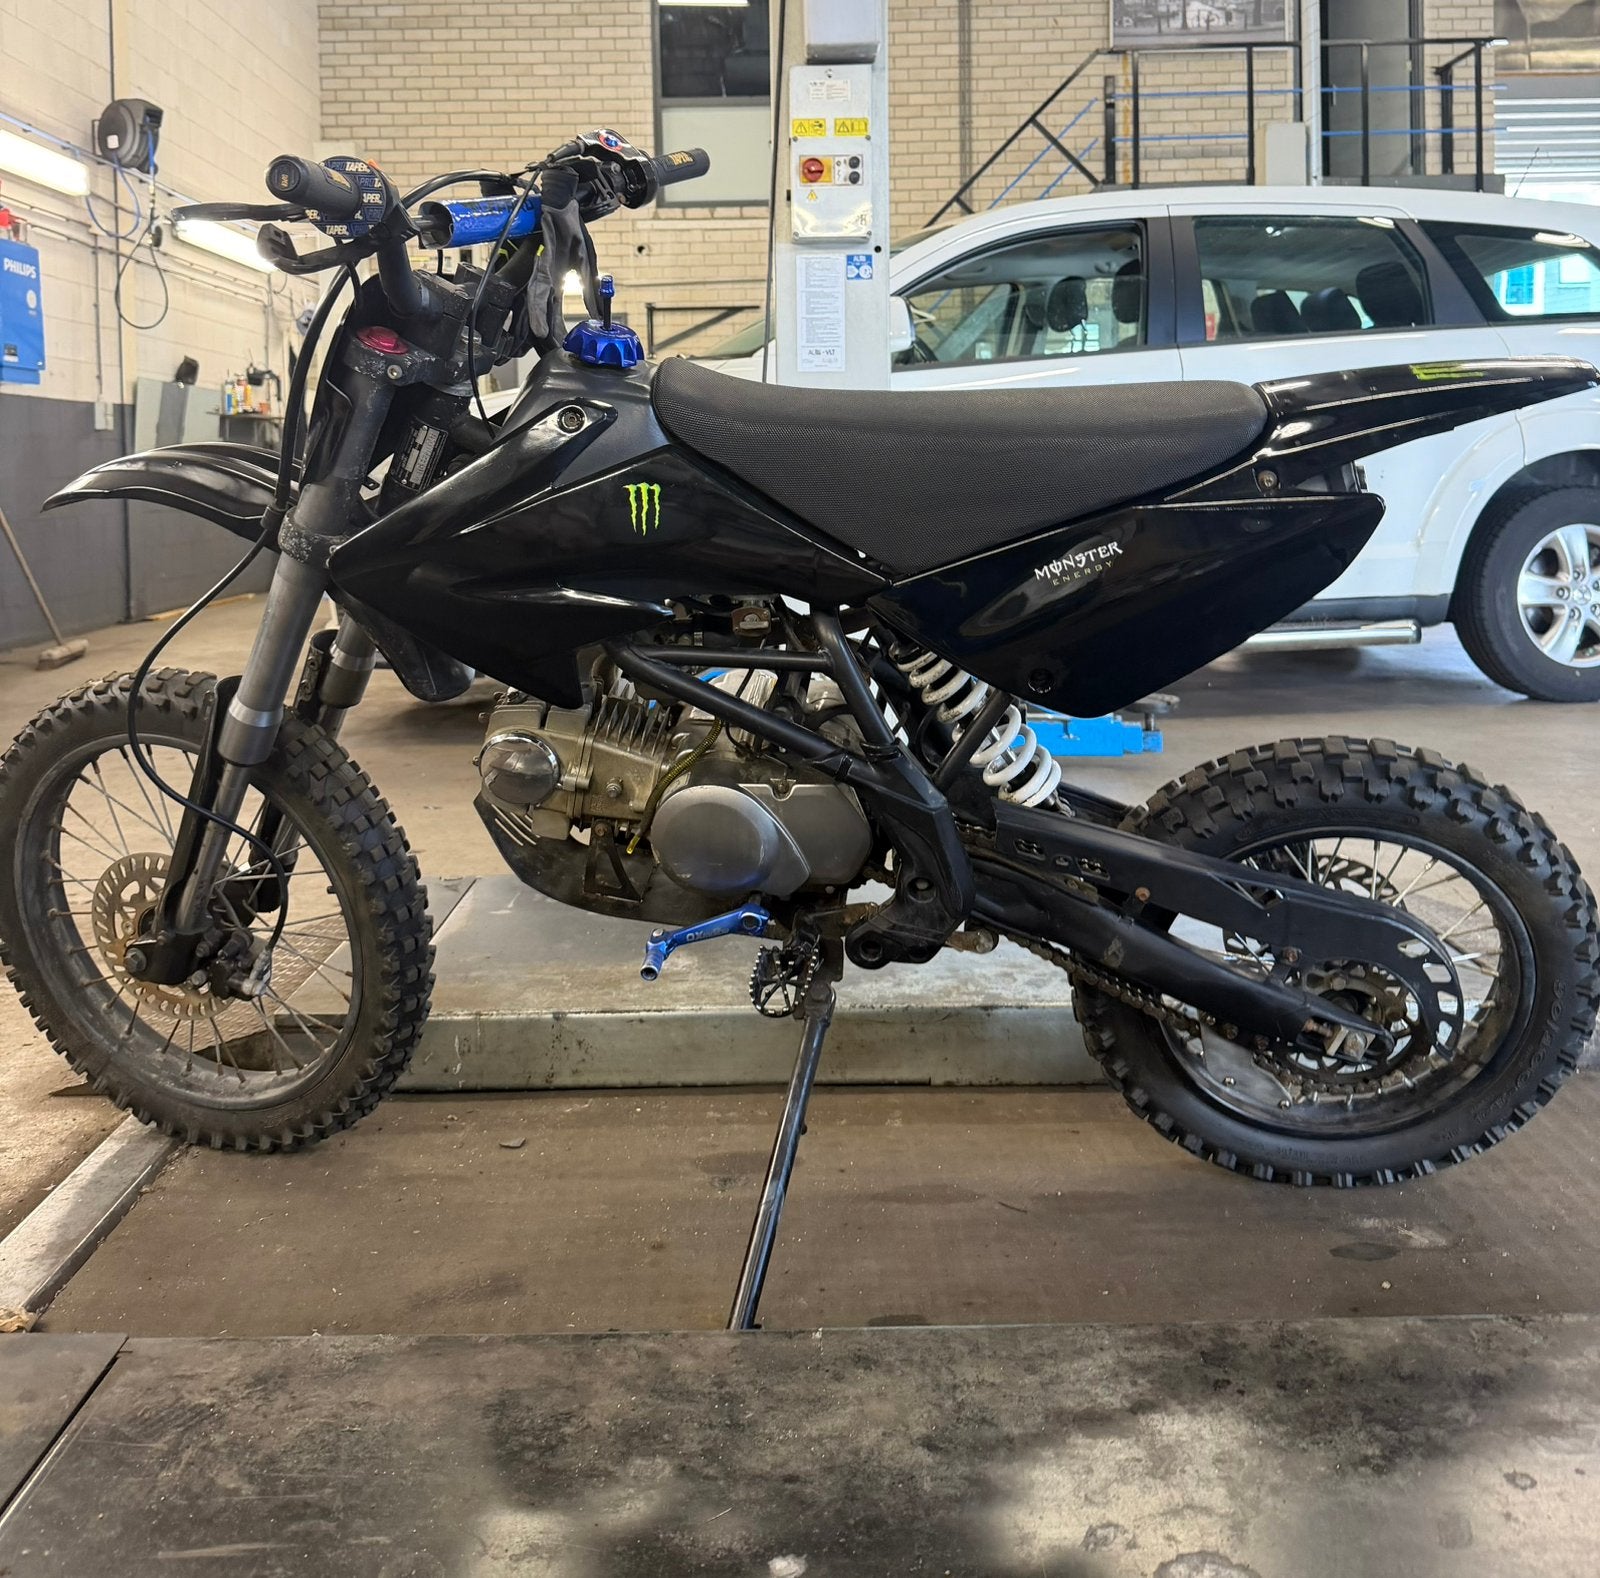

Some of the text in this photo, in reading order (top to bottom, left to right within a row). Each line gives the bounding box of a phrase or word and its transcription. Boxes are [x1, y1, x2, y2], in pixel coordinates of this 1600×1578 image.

[325, 224, 349, 236] TAPER
[4, 258, 36, 279] PHILIPS
[1034, 541, 1124, 580] MONSTER
[1052, 560, 1113, 586] ENERGY
